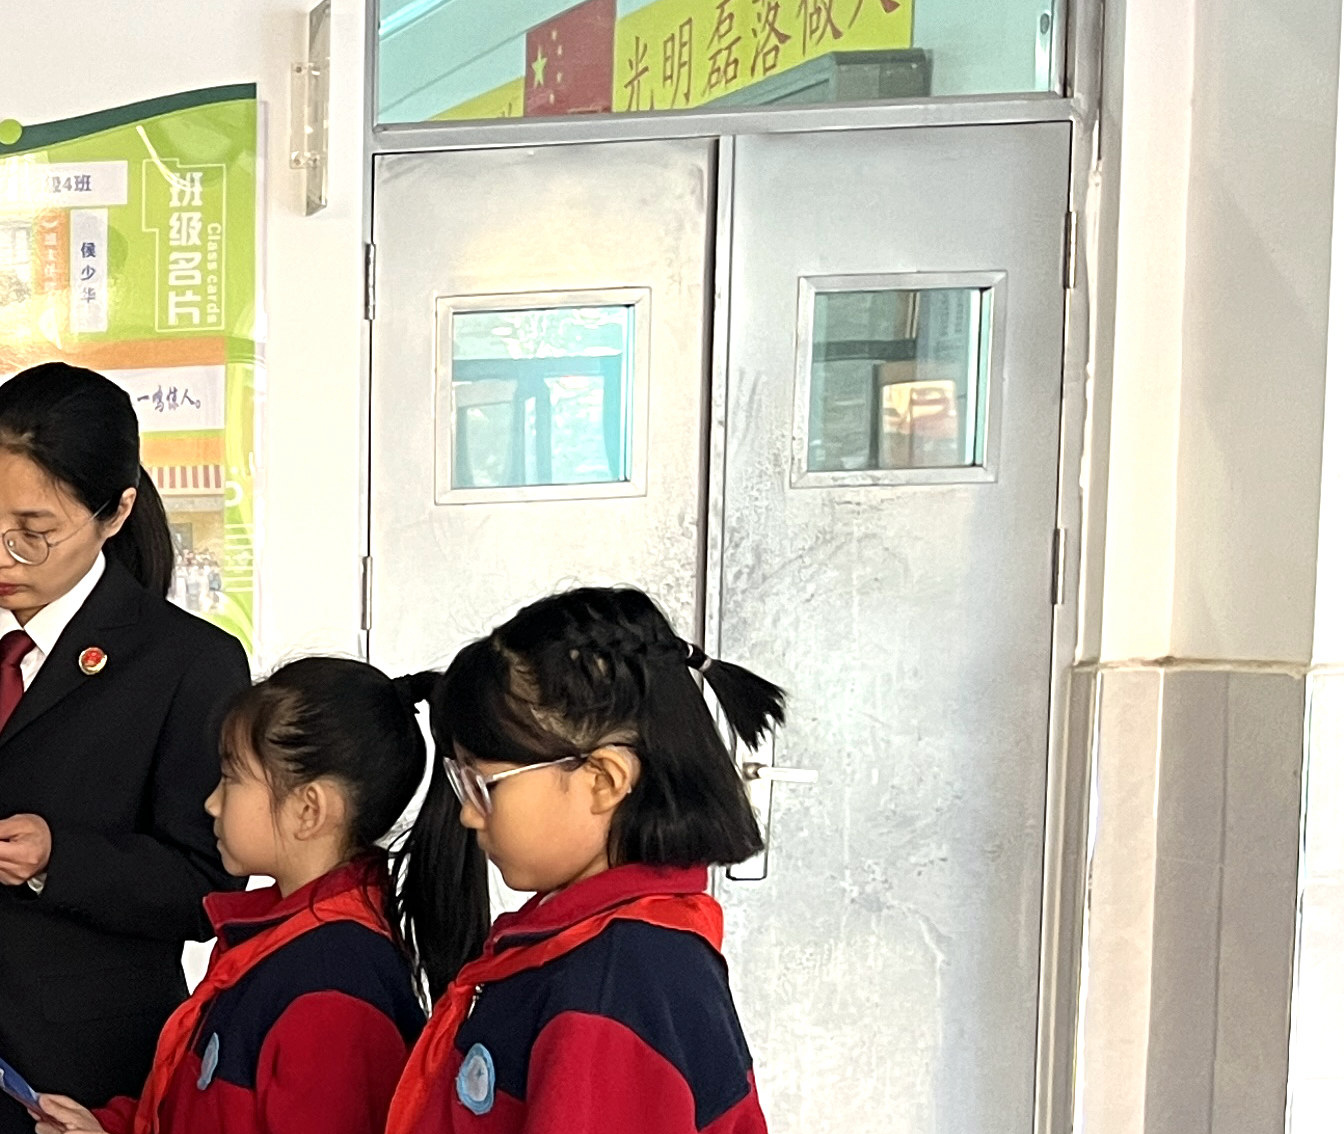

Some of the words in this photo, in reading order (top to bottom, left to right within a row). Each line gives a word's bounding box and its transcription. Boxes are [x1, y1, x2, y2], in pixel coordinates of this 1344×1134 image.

[624, 0, 901, 111] 光明磊落做
[167, 172, 203, 326] 班级名片
[206, 222, 222, 271] Class
[205, 274, 221, 324] cards
